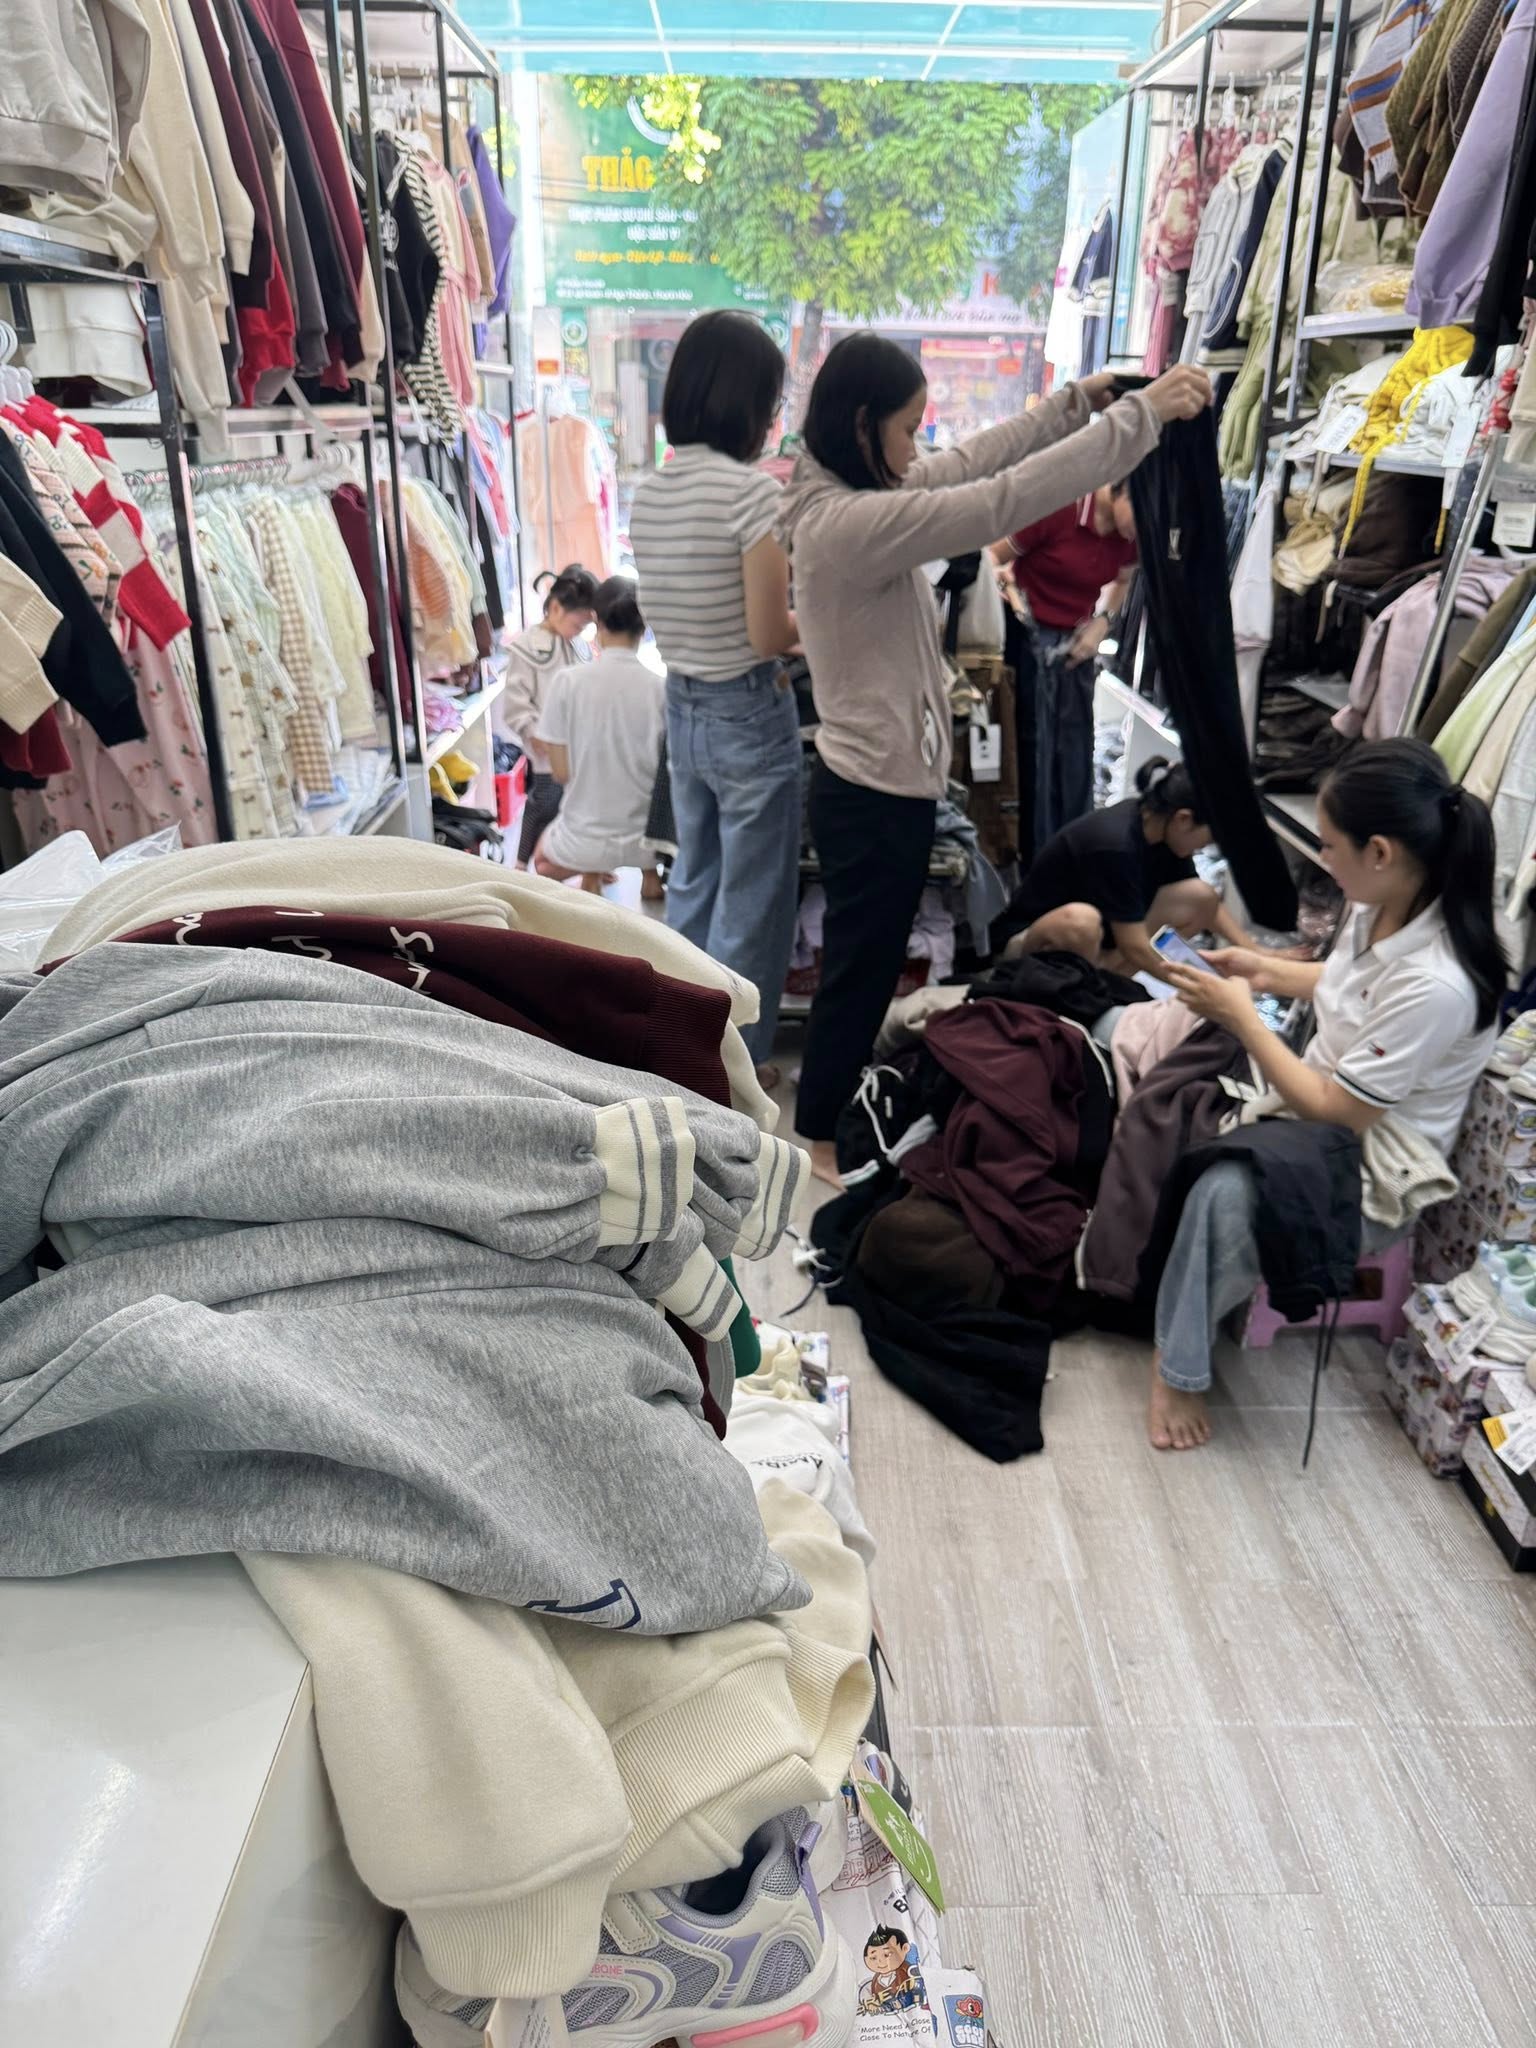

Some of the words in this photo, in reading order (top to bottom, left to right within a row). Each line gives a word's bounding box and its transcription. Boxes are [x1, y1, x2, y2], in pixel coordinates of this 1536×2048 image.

[911, 2018, 931, 2026] Close
[860, 2034, 880, 2042] Close
[921, 2026, 931, 2034] Of
